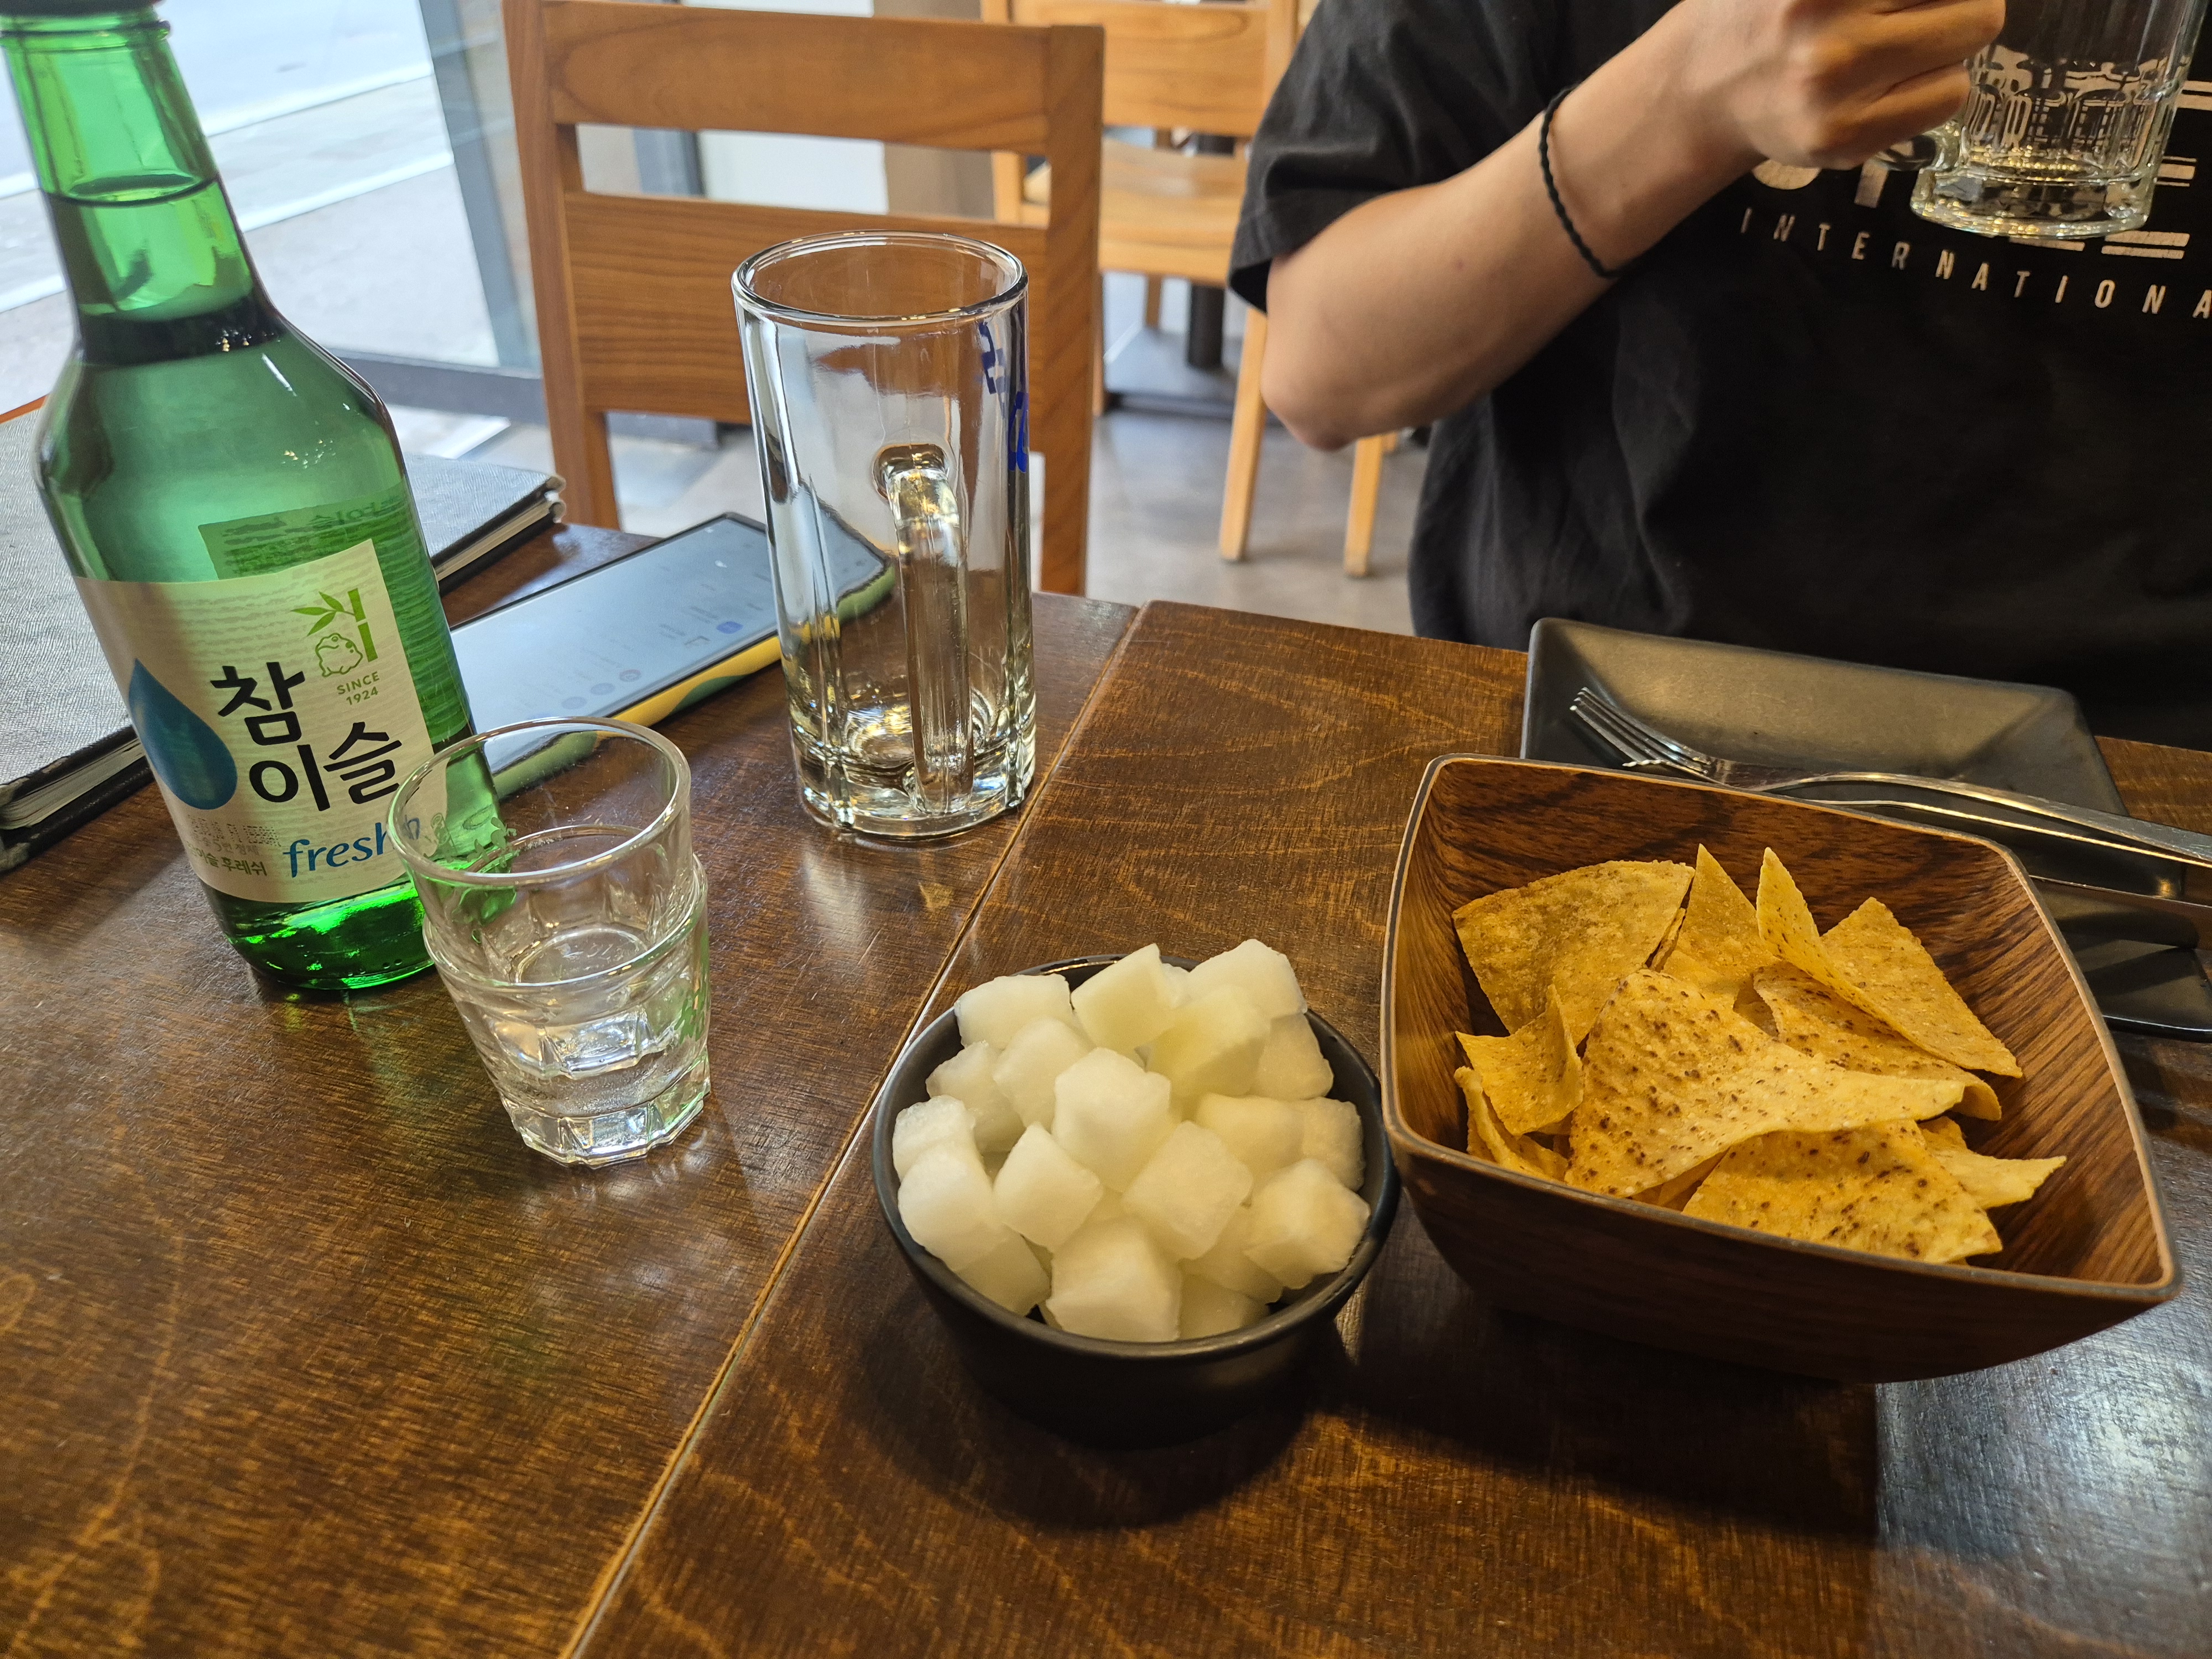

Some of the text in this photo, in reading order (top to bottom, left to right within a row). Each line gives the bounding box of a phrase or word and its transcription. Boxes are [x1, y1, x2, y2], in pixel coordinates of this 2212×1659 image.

[337, 671, 379, 695] SINCE
[346, 686, 378, 705] 1924
[283, 822, 389, 878] fresh
[221, 857, 267, 876] 후레쉬
